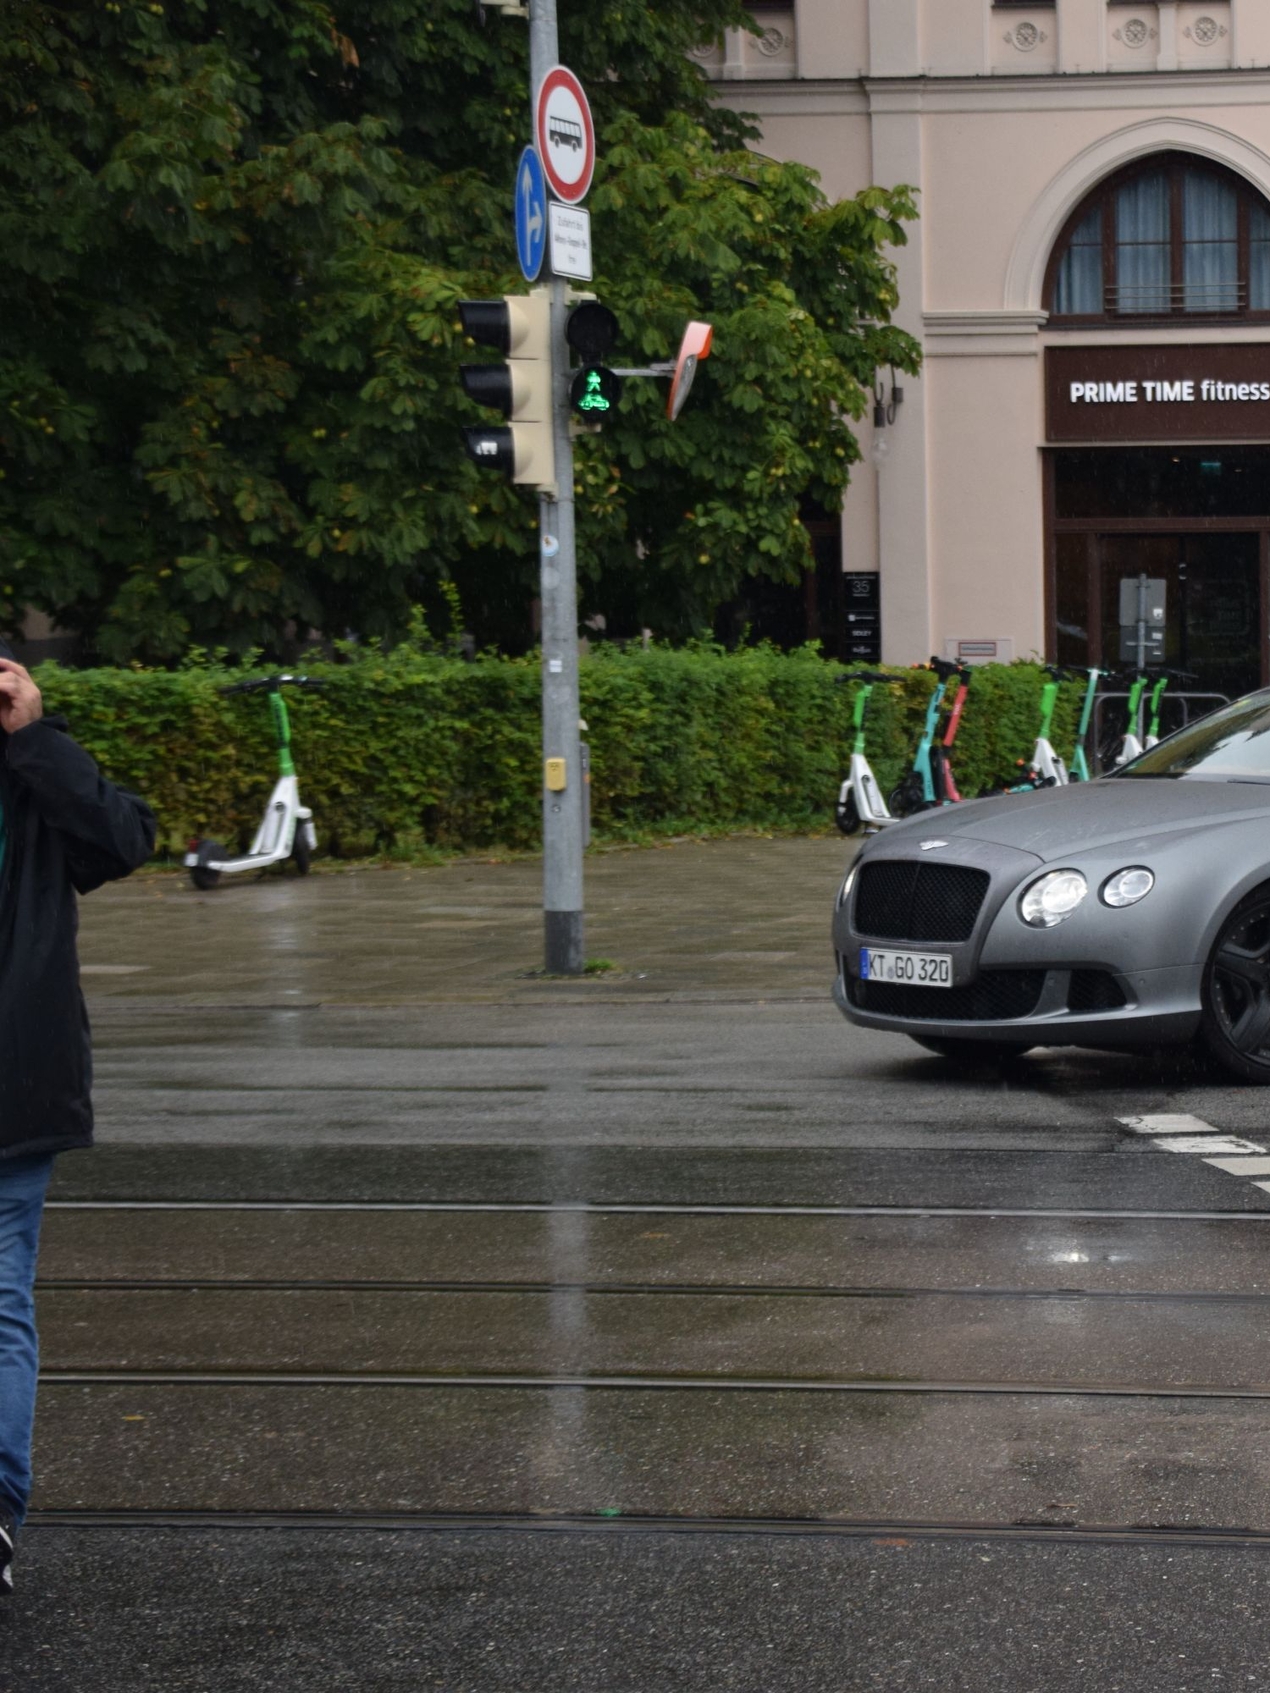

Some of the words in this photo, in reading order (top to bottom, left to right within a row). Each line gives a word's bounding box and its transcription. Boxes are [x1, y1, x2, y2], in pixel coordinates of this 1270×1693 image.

[1070, 382, 1138, 402] PRIME
[1142, 380, 1195, 402] TIME
[1200, 380, 1270, 401] fitness
[852, 580, 870, 594] 35
[869, 954, 886, 978] KT
[895, 956, 915, 980] GO
[918, 958, 950, 982] 320
